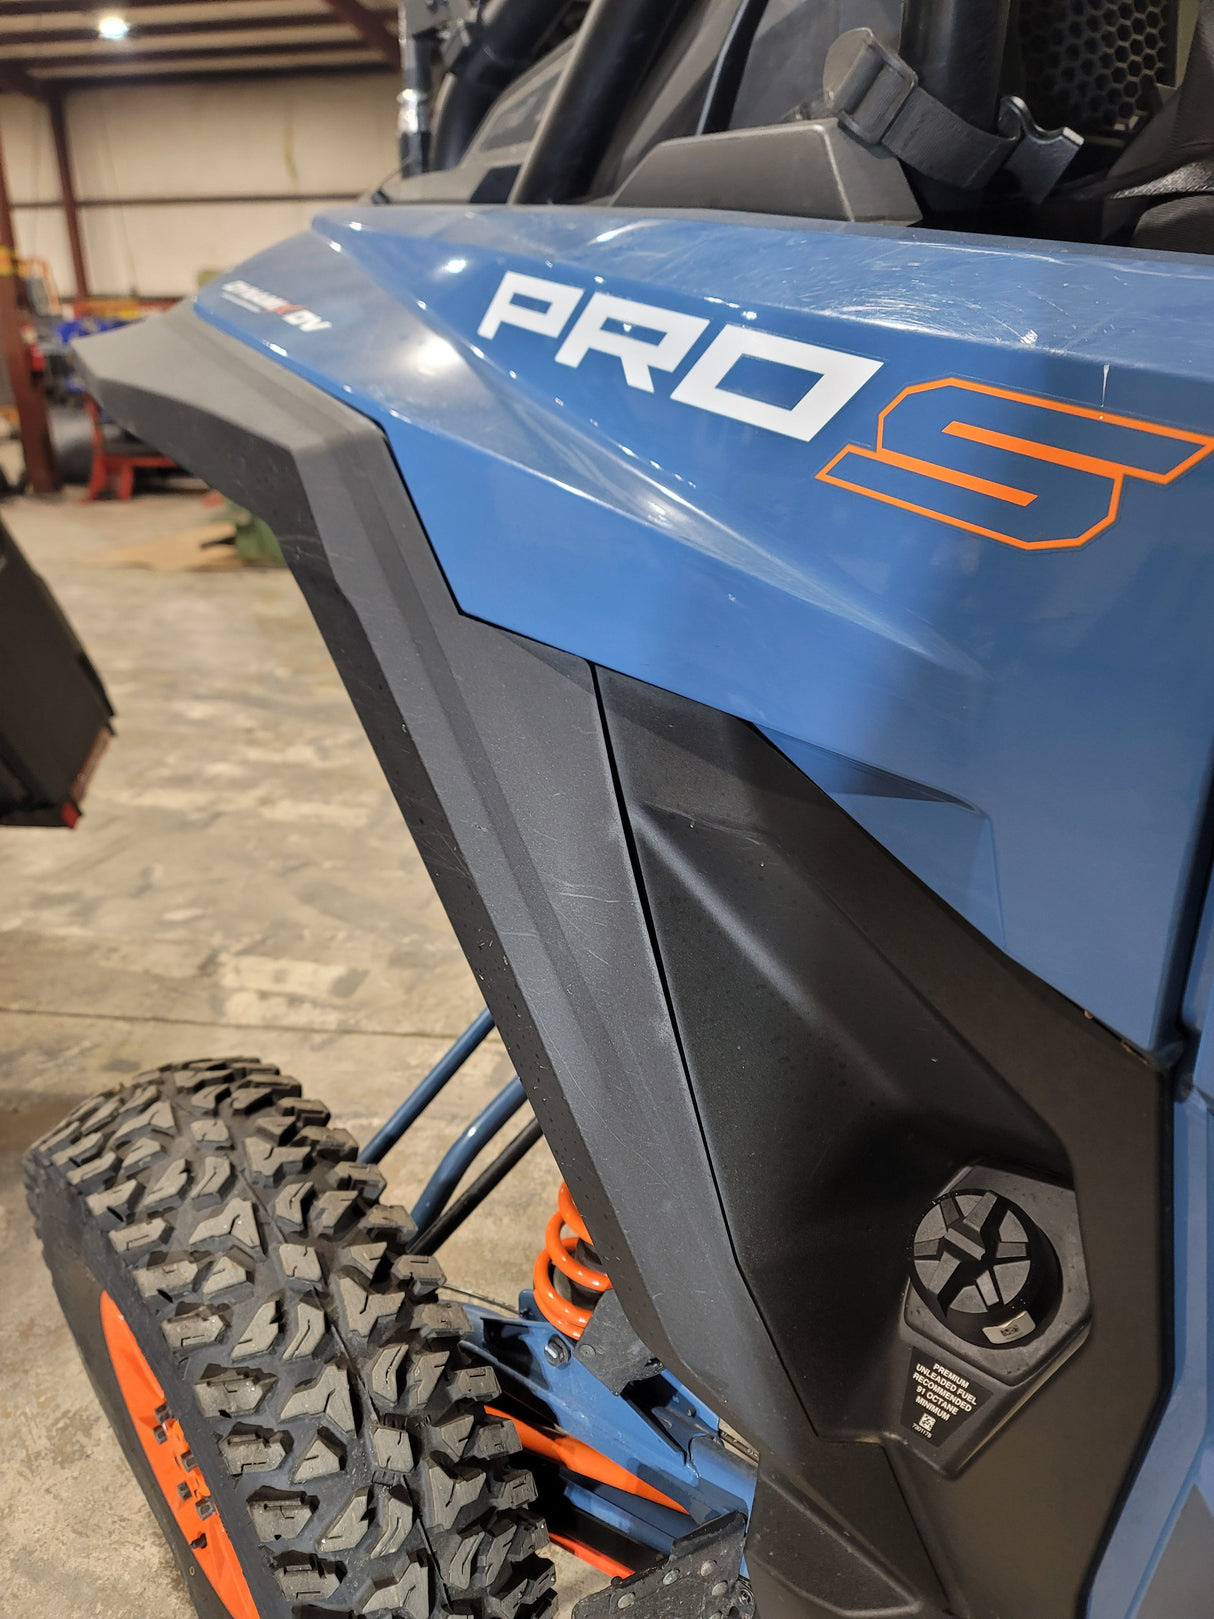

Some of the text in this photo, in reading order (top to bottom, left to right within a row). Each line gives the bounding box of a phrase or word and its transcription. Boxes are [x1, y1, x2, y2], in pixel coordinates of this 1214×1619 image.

[477, 270, 1214, 550] PRO S
[912, 1372, 972, 1412] RECOMMENDED
[915, 1363, 977, 1406] UNLEADED FUEL
[933, 1363, 970, 1389] PREMIUM
[915, 1395, 951, 1422] MINIMUM
[916, 1385, 959, 1416] 91 OCTANE
